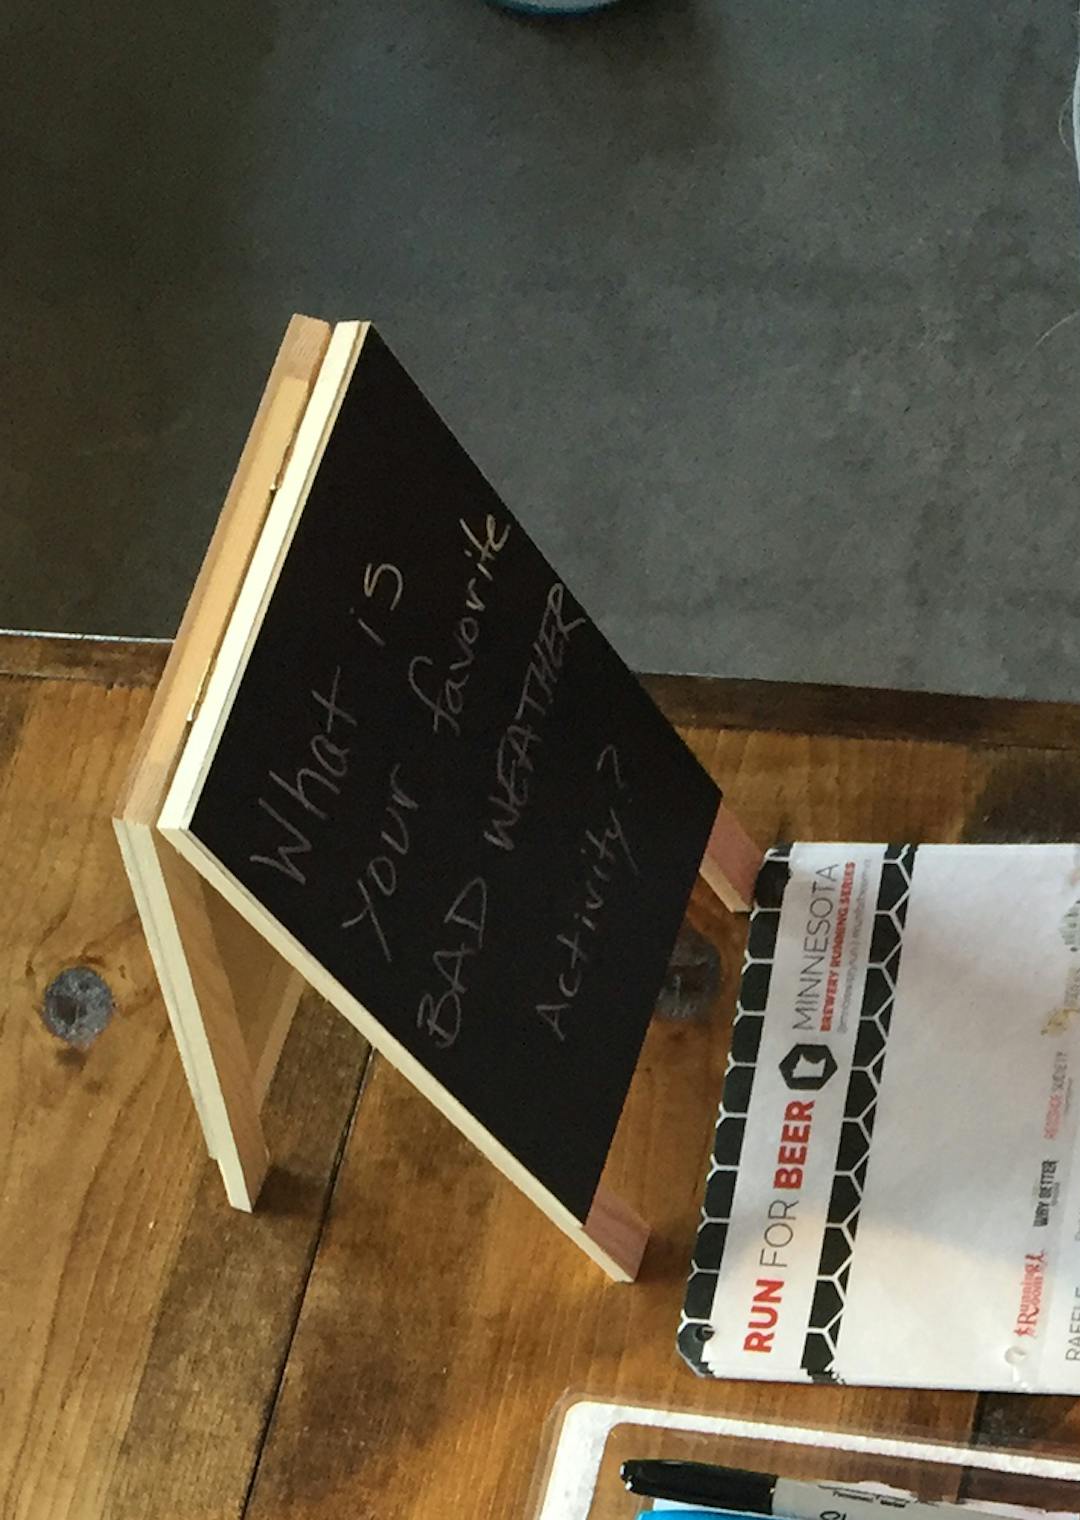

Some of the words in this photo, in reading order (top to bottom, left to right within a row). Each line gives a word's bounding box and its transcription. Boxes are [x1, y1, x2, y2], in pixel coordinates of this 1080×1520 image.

[408, 514, 510, 735] favorite
[250, 666, 358, 884] What
[350, 562, 403, 646] is
[417, 876, 488, 1048] BAD
[484, 582, 586, 851] WEATHER
[535, 806, 638, 1041] Activity
[793, 863, 840, 1031] MINNESOTA
[759, 1200, 799, 1267] FOR
[773, 1099, 816, 1189] BEER
[743, 1279, 785, 1353] RUN
